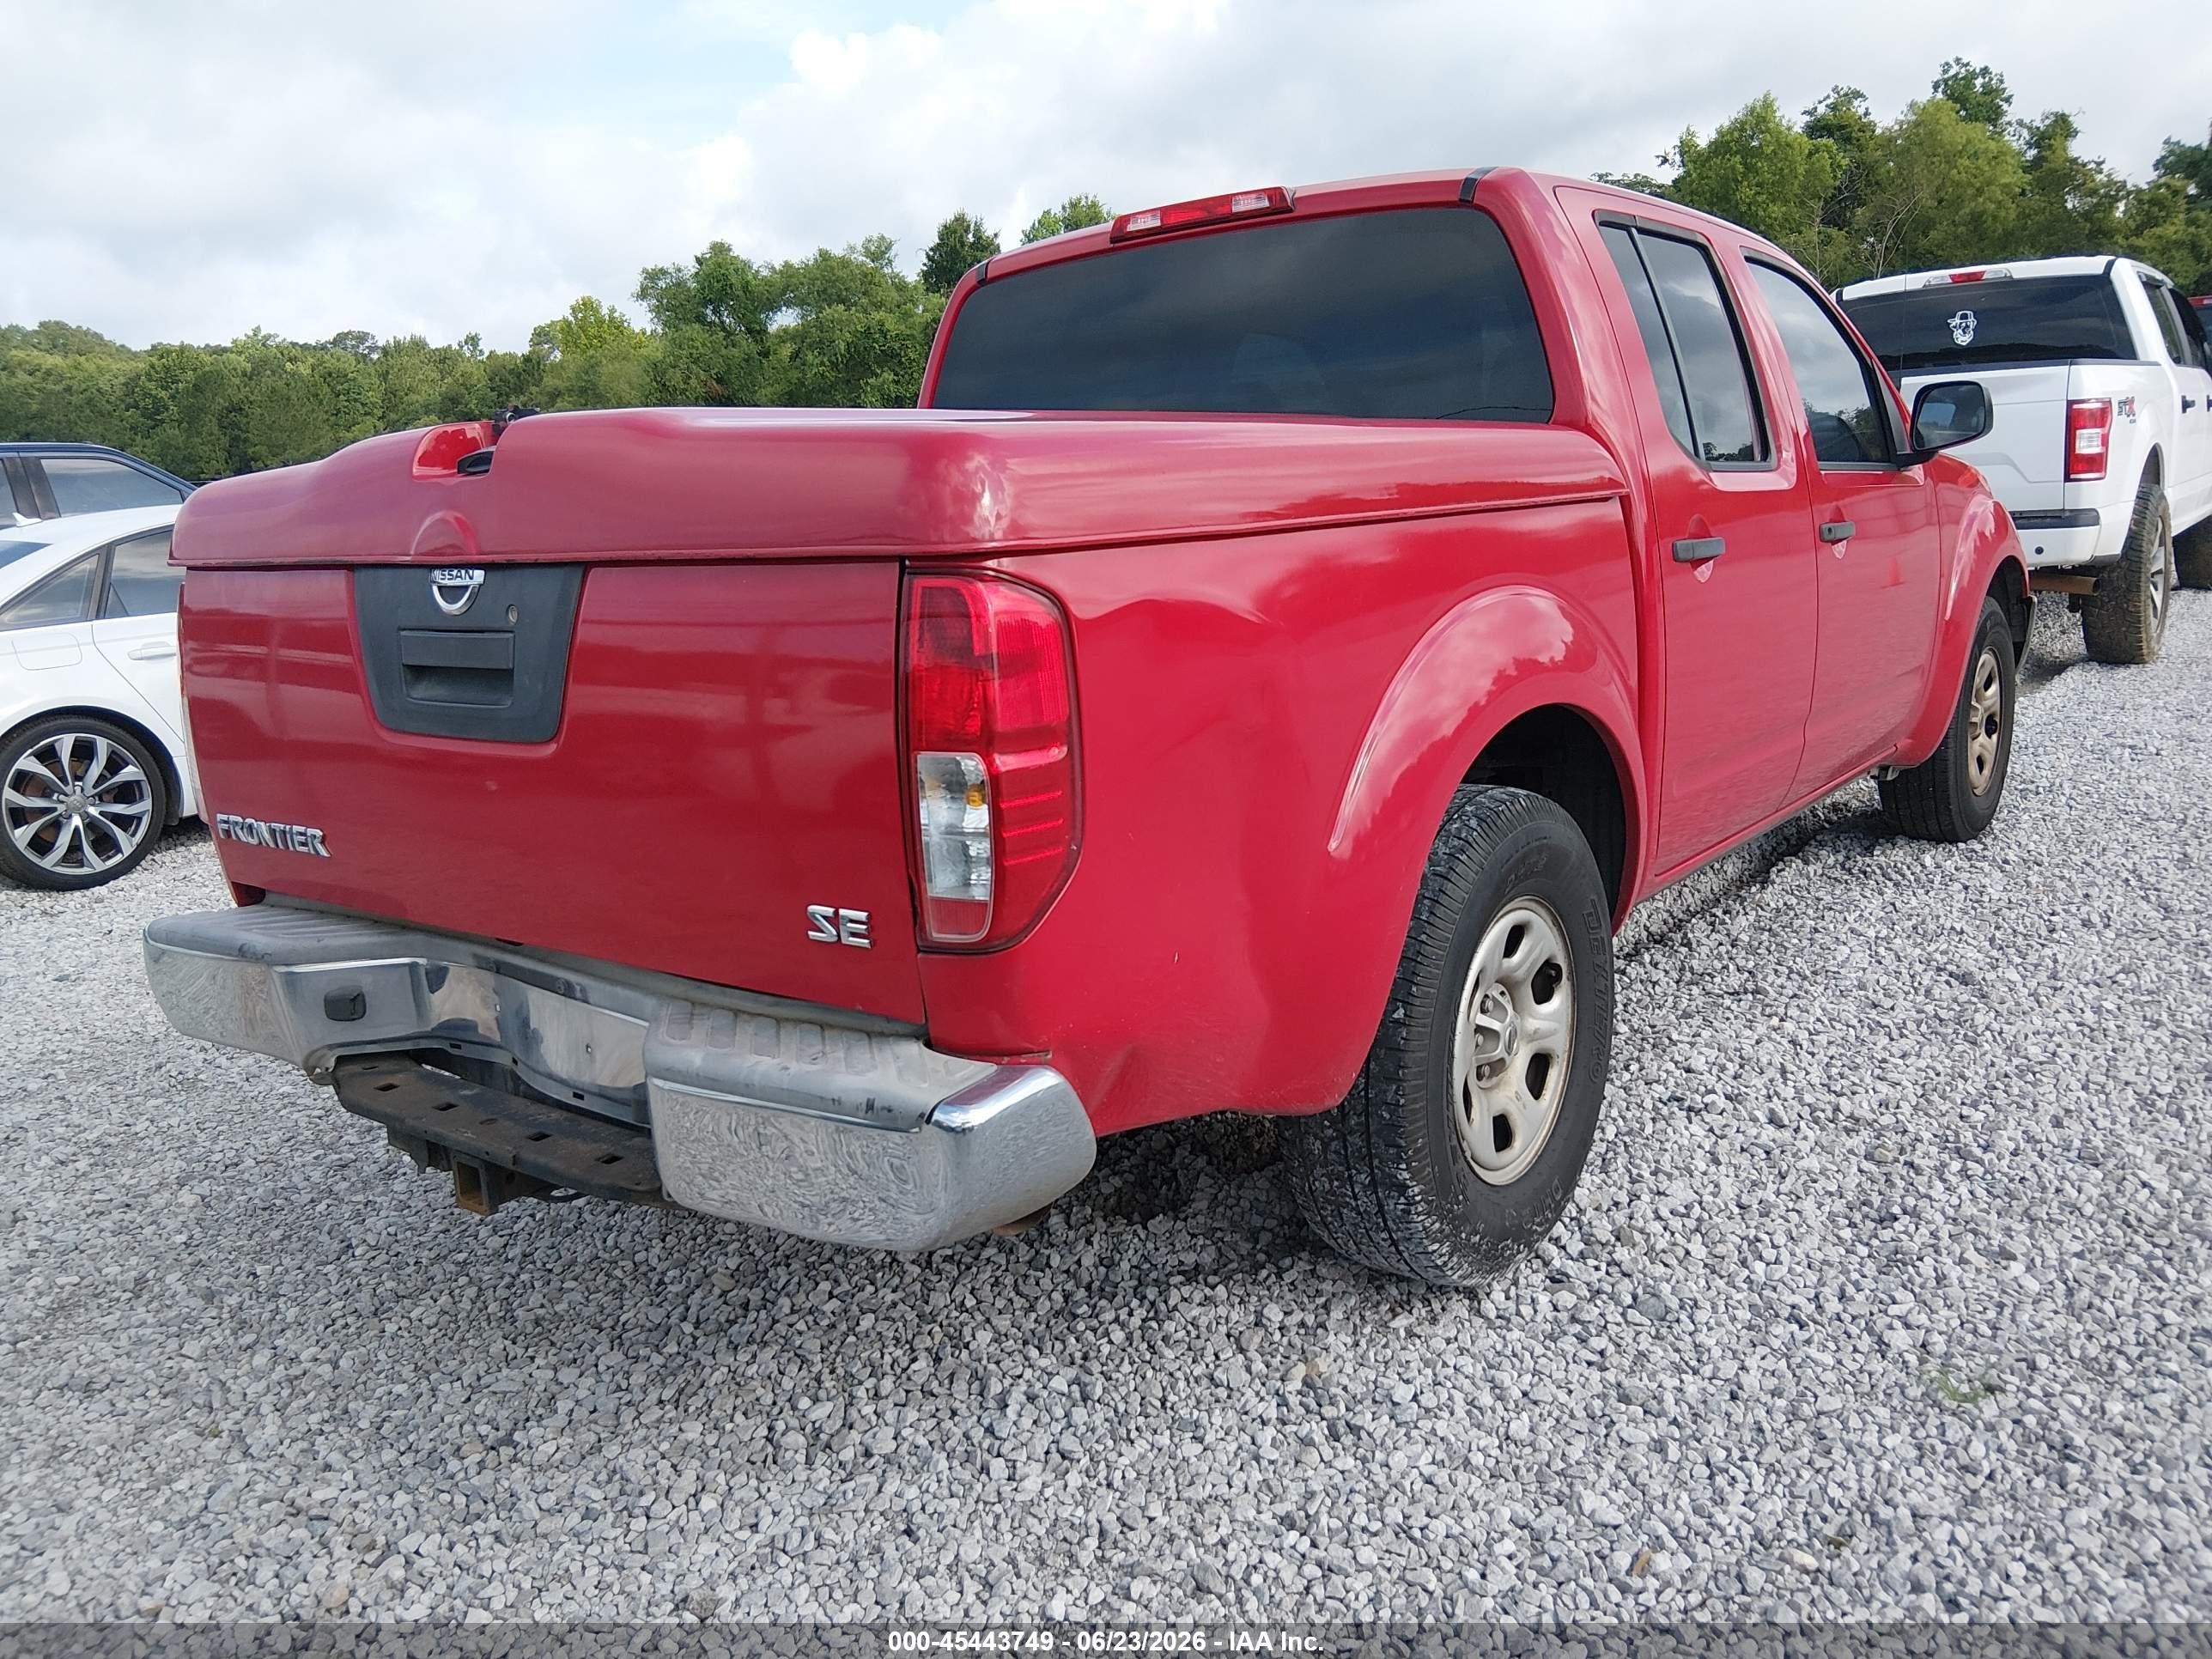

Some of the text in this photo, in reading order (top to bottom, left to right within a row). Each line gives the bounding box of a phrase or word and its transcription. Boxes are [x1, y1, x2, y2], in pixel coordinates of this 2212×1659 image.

[430, 568, 474, 580] NISSAN
[216, 812, 331, 857] FRONTIER
[806, 904, 872, 949] SE
